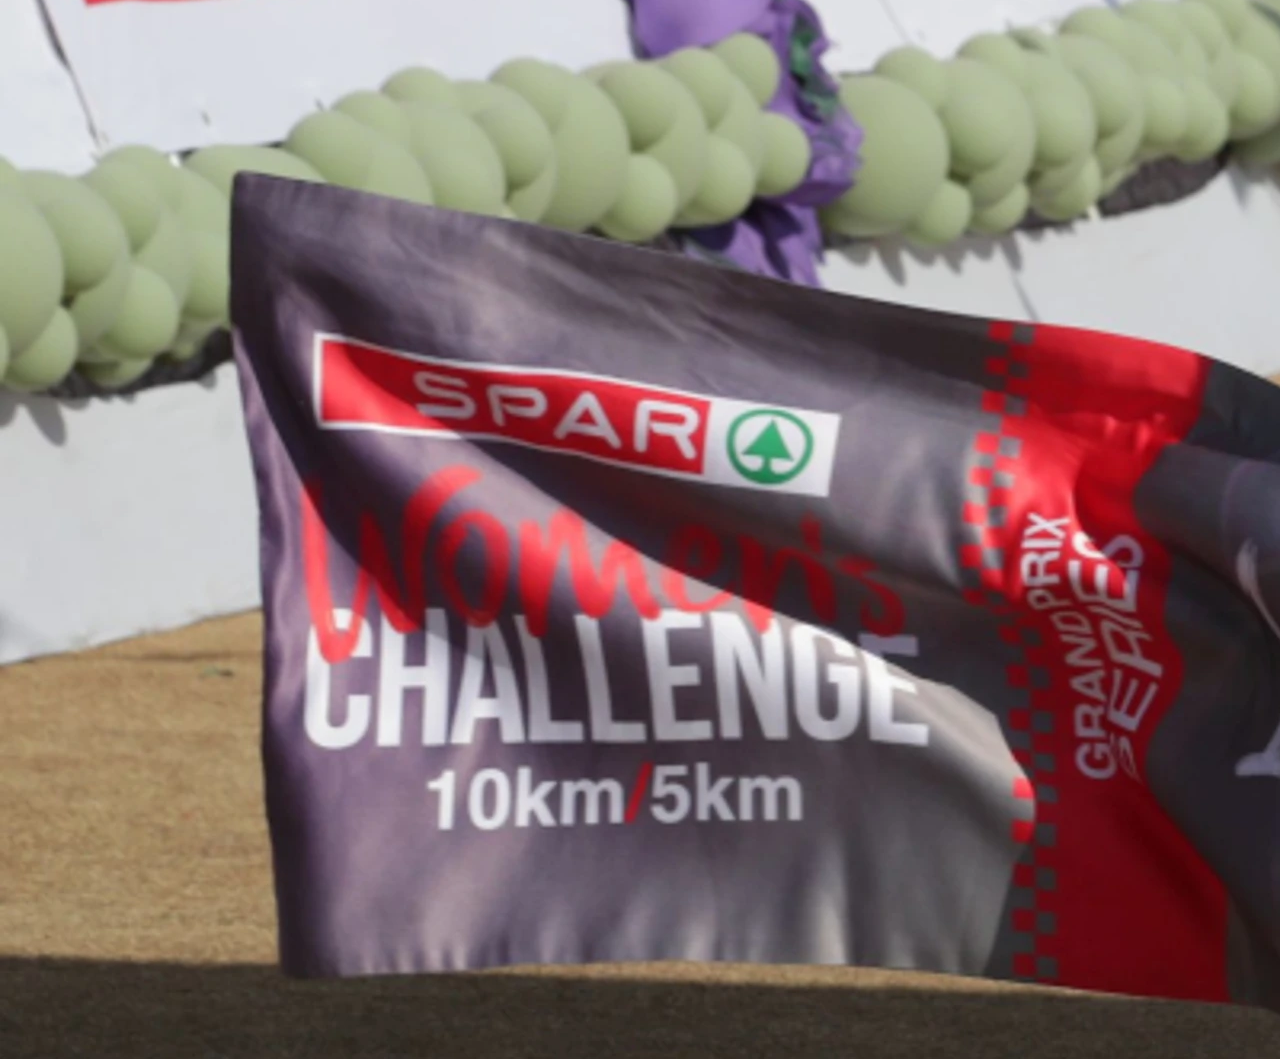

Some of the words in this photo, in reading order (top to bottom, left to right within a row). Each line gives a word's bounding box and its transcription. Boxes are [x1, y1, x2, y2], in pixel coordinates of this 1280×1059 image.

[412, 370, 701, 460] SPAR
[301, 465, 908, 664] Women's
[302, 606, 930, 750] CHALLENGE
[427, 761, 803, 832] 10km/5km
